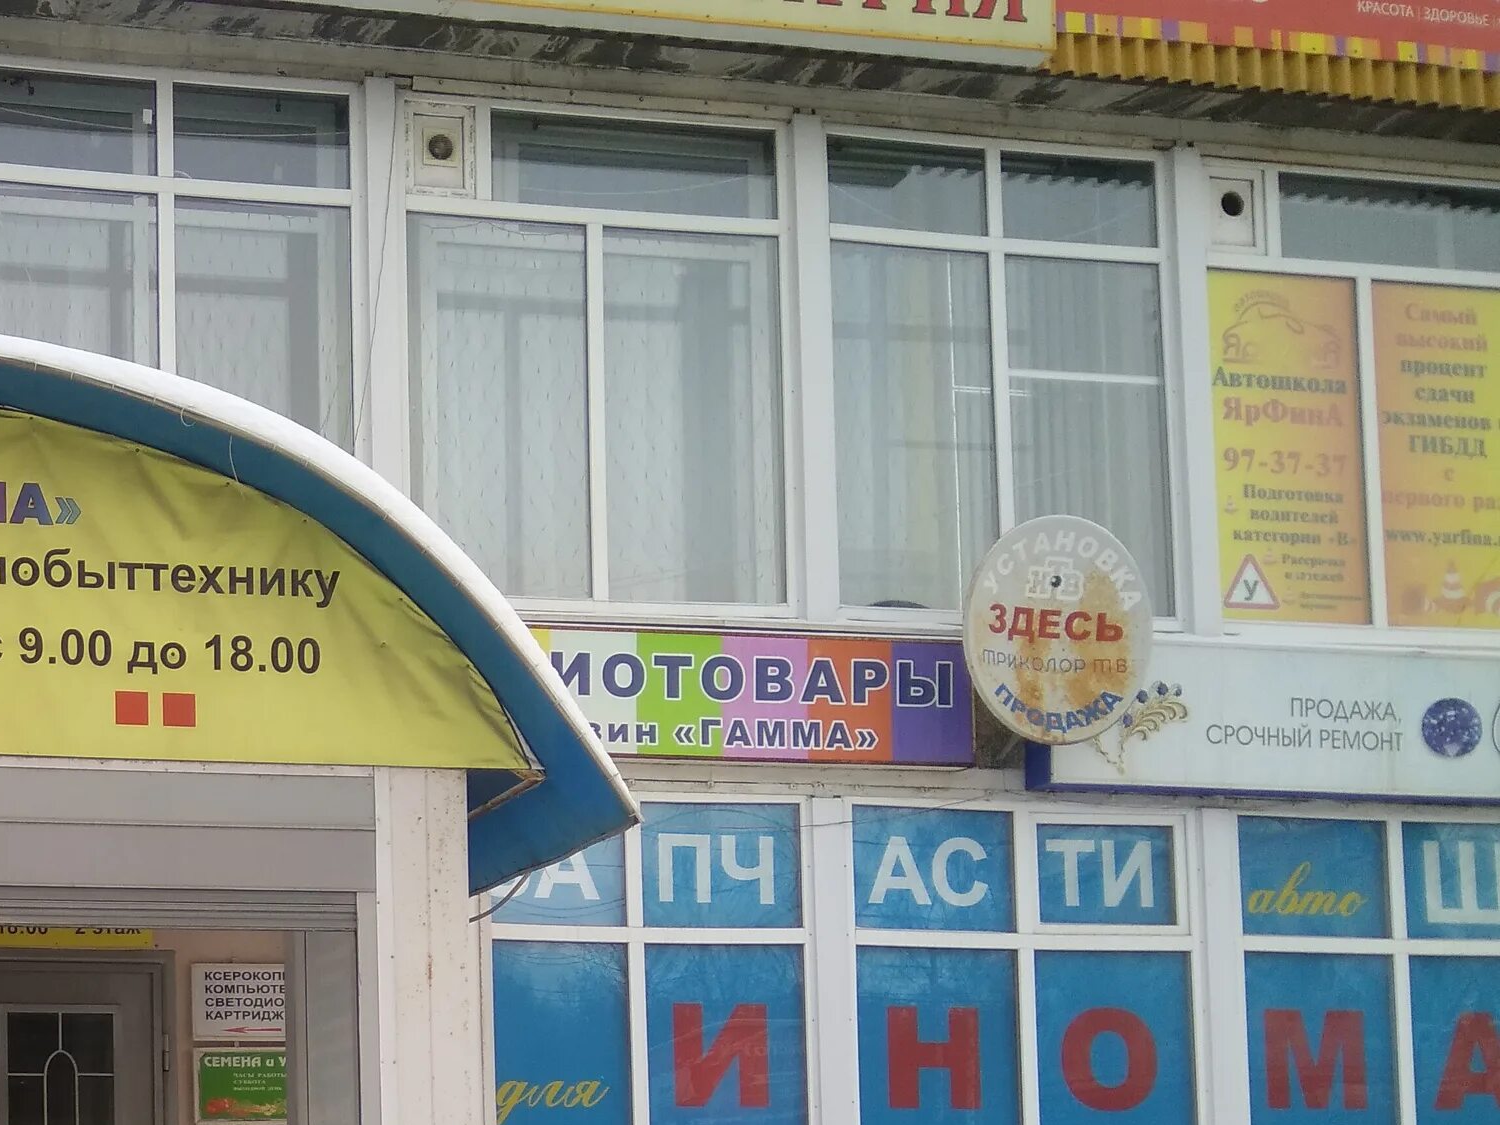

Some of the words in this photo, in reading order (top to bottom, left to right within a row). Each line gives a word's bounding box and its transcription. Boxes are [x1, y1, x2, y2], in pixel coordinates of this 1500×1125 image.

[1424, 7, 1489, 26] ЗДОРОВЬЕ
[1400, 360, 1488, 377] процент
[1212, 366, 1346, 394] Автошкола
[1414, 387, 1475, 403] сдачи
[1381, 411, 1492, 429] экзаменов
[1408, 435, 1488, 459] ГИБДД
[1223, 447, 1348, 477] 97-37-37
[1243, 484, 1344, 503] Подготовка
[1250, 507, 1339, 524] водителей
[1233, 528, 1321, 546] категории
[983, 530, 1141, 610] УСТАНОВКА
[988, 604, 1123, 643] ЗДЕСЬ
[20, 628, 113, 666] 9.00
[128, 639, 187, 673] до
[205, 634, 320, 674] 18.00
[994, 683, 1124, 733] ПРОДАЖА
[1291, 697, 1402, 723] ПРОДАЖА,
[674, 717, 878, 750] «ГАММА»
[1206, 723, 1312, 749] СРОЧНЫЙ
[1320, 730, 1403, 752] РЕМОНТ
[204, 984, 285, 994] КОМПЬЮТЕ
[205, 997, 284, 1008] СВЕТОДИО
[205, 1010, 284, 1021] КАРТРИДЖ
[204, 1056, 261, 1067] СЕМЕНА
